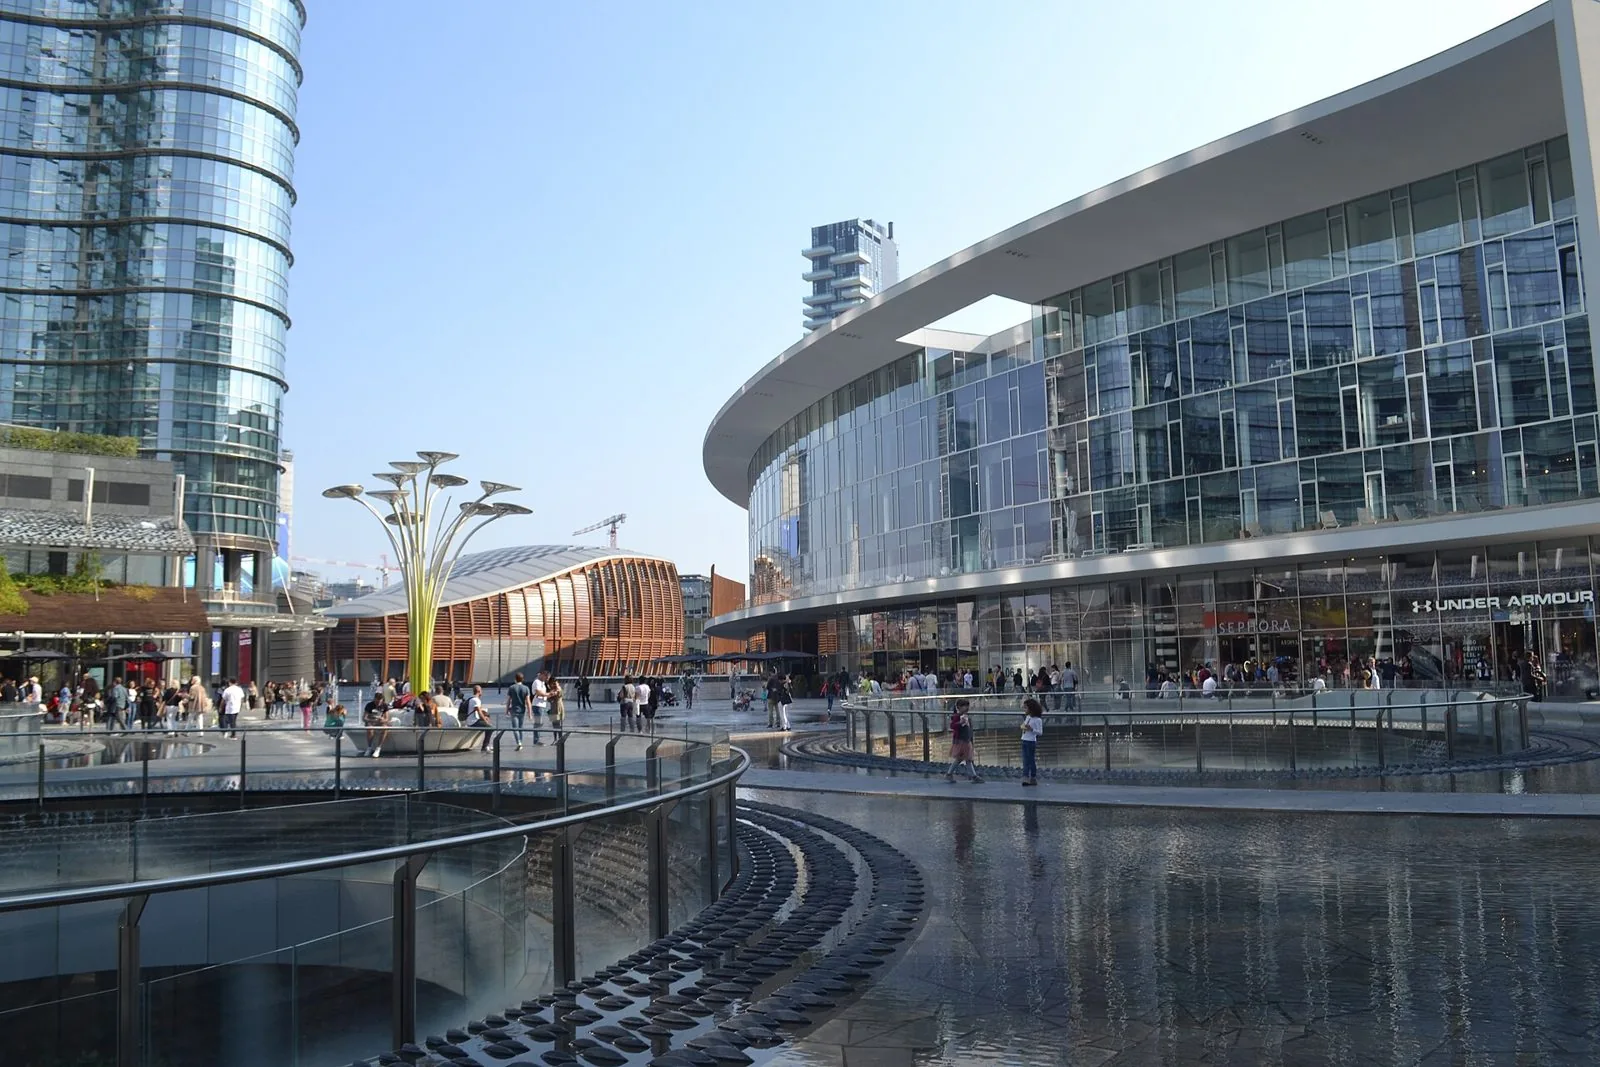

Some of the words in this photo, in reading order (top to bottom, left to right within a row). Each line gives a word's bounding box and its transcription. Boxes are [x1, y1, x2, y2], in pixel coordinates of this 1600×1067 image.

[1435, 597, 1500, 611] UNDER
[1508, 590, 1594, 607] ARMOUR
[1218, 619, 1292, 634] SEPHORA
